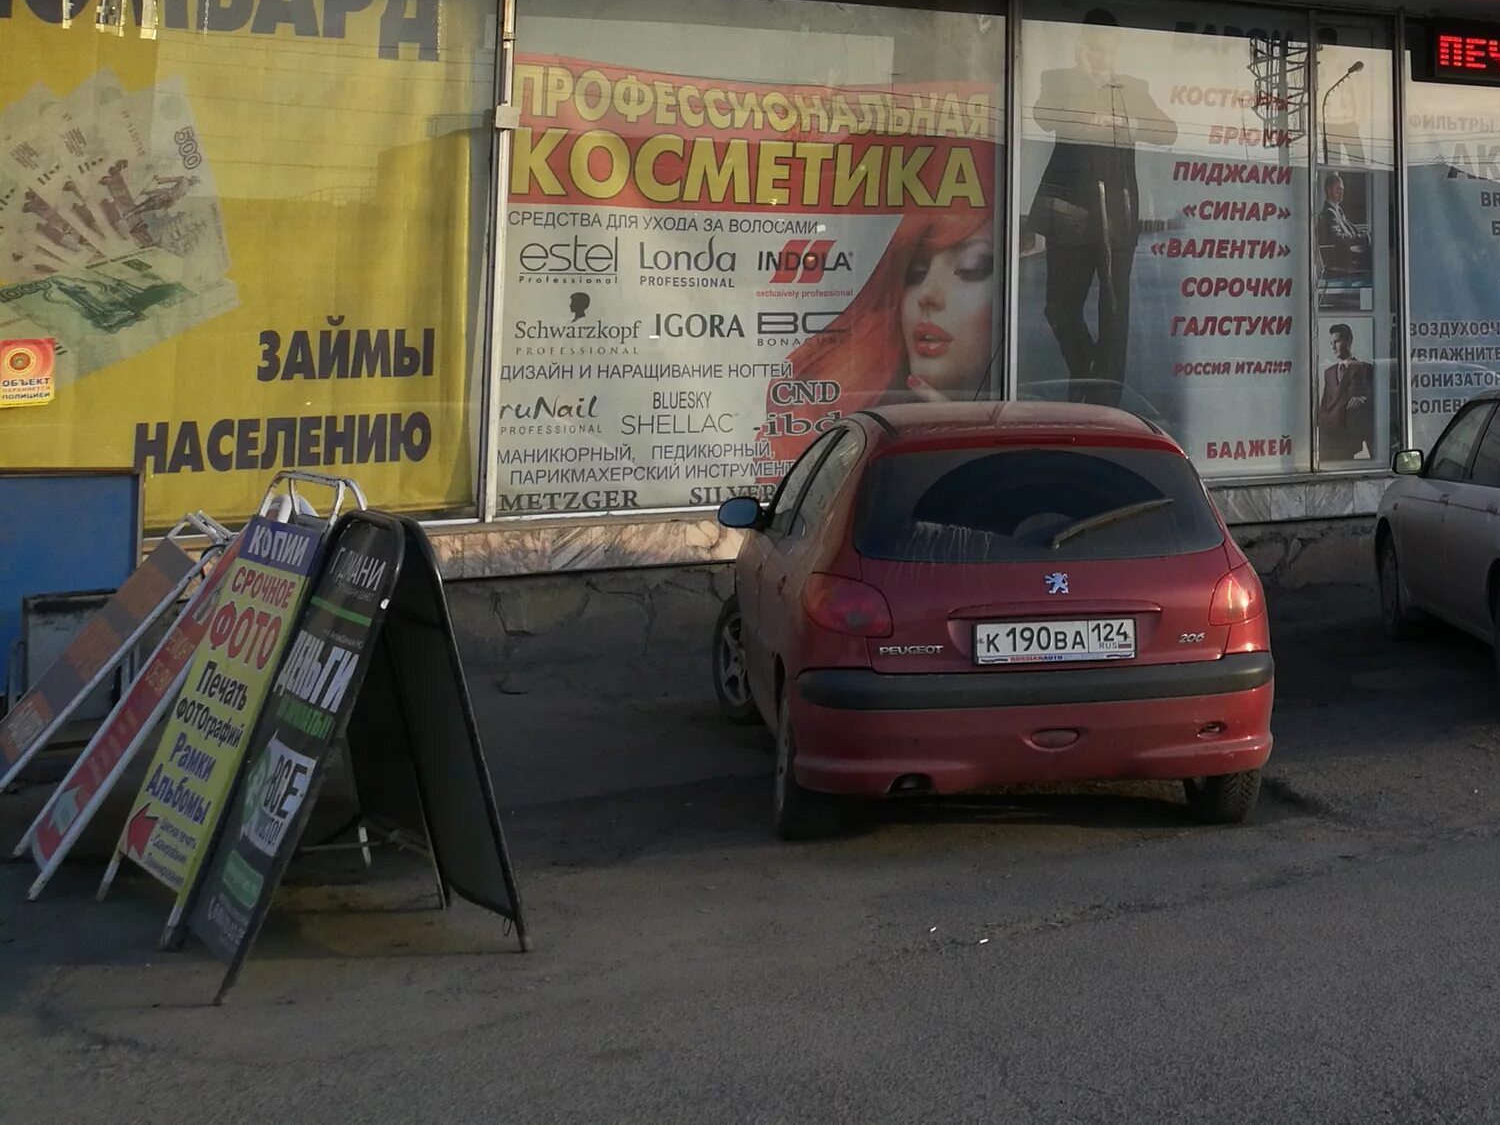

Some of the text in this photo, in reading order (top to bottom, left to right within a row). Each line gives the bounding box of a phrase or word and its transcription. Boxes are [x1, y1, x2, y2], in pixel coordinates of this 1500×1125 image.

[514, 64, 990, 139] ПРОФЕССИОНАЛЬНАЯ
[174, 125, 202, 170] 500
[509, 127, 987, 208] КОСМЕТИКА
[1173, 161, 1292, 187] ПИДЖАКИ
[508, 210, 818, 235] СРЕДСТВА ДЛЯ УХОДА ЗА ВОЛОСАМИ
[1183, 201, 1291, 221] «СИНАР»
[519, 235, 618, 272] estel
[639, 235, 736, 272] Londa
[757, 249, 852, 272] INDOLA
[1151, 239, 1291, 260] «ВАЛЕНТИ»
[518, 275, 618, 285] Professional
[640, 276, 735, 288] PROFESSIONAL
[1181, 277, 1292, 298] СОРОЧКИ
[756, 289, 853, 299] exclusively professional
[515, 319, 642, 343] Schwarzkopf
[655, 313, 745, 339] IGORA
[757, 312, 850, 334] BC
[1170, 316, 1292, 337] ГАЛСТУКИ
[257, 315, 435, 381] ЗАЙМЫ
[516, 346, 639, 355] PROFESSIONAL
[500, 359, 792, 381] ДИЗАЙН И НАРАЩИВАНИЕ НОГТЕЙ
[1174, 359, 1292, 376] РОССИЯ ИТАЛИЯ
[2, 377, 50, 387] ОБЪЕКТ
[771, 380, 841, 405] CND
[500, 394, 598, 421] ruNail
[652, 391, 712, 410] BLUESKY
[1411, 399, 1466, 415] СОЛЕВ
[501, 425, 601, 436] PROFESSIONAL
[621, 413, 734, 436] SHELLAC
[133, 411, 432, 474] НАСЕЛЕНИЮ
[497, 442, 774, 465] МАНИКЮРНЫЙ, ПЕДИКЮРНЫЙ,
[1206, 434, 1292, 461] БАДЖЕЙ
[510, 464, 680, 485] ПАРИКМАХЕРСКИЙ
[499, 490, 639, 511] METZGER
[248, 525, 310, 567] КОПИИ
[231, 566, 297, 609] СРОЧНОЕ
[210, 601, 282, 671] ФОТО
[1091, 622, 1129, 642] 124
[1178, 632, 1205, 643] 206
[879, 643, 944, 656] PEUGEOT
[196, 660, 249, 711] Печать
[169, 732, 217, 782] Рамки
[145, 763, 212, 825] Альбомы
[264, 754, 309, 819] ВСЕ
